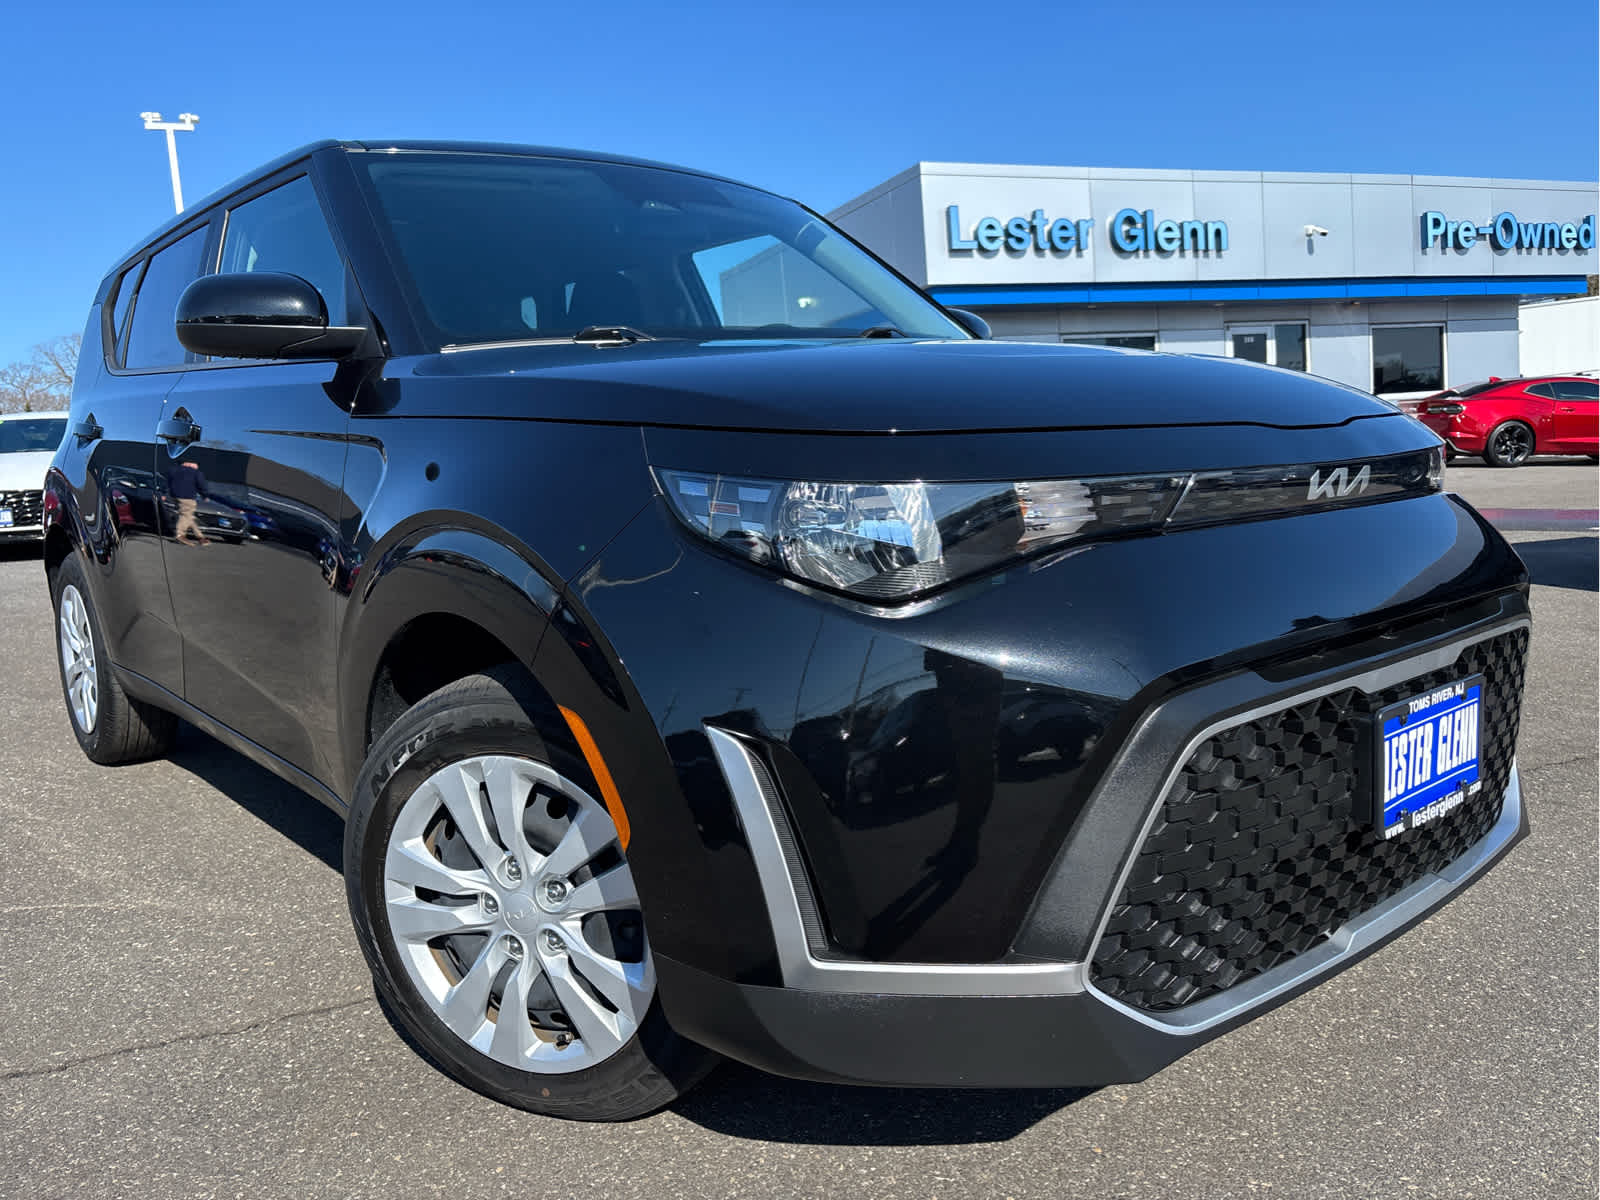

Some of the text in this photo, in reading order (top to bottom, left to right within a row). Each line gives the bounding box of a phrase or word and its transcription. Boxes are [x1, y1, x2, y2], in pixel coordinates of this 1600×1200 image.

[946, 205, 1229, 252] Lester Glenn
[1421, 211, 1596, 250] Pre-Owned
[1307, 465, 1371, 500] KIA
[1408, 682, 1465, 715] TOMS RIVER, NJ
[1384, 703, 1479, 804] LESTER GLENN
